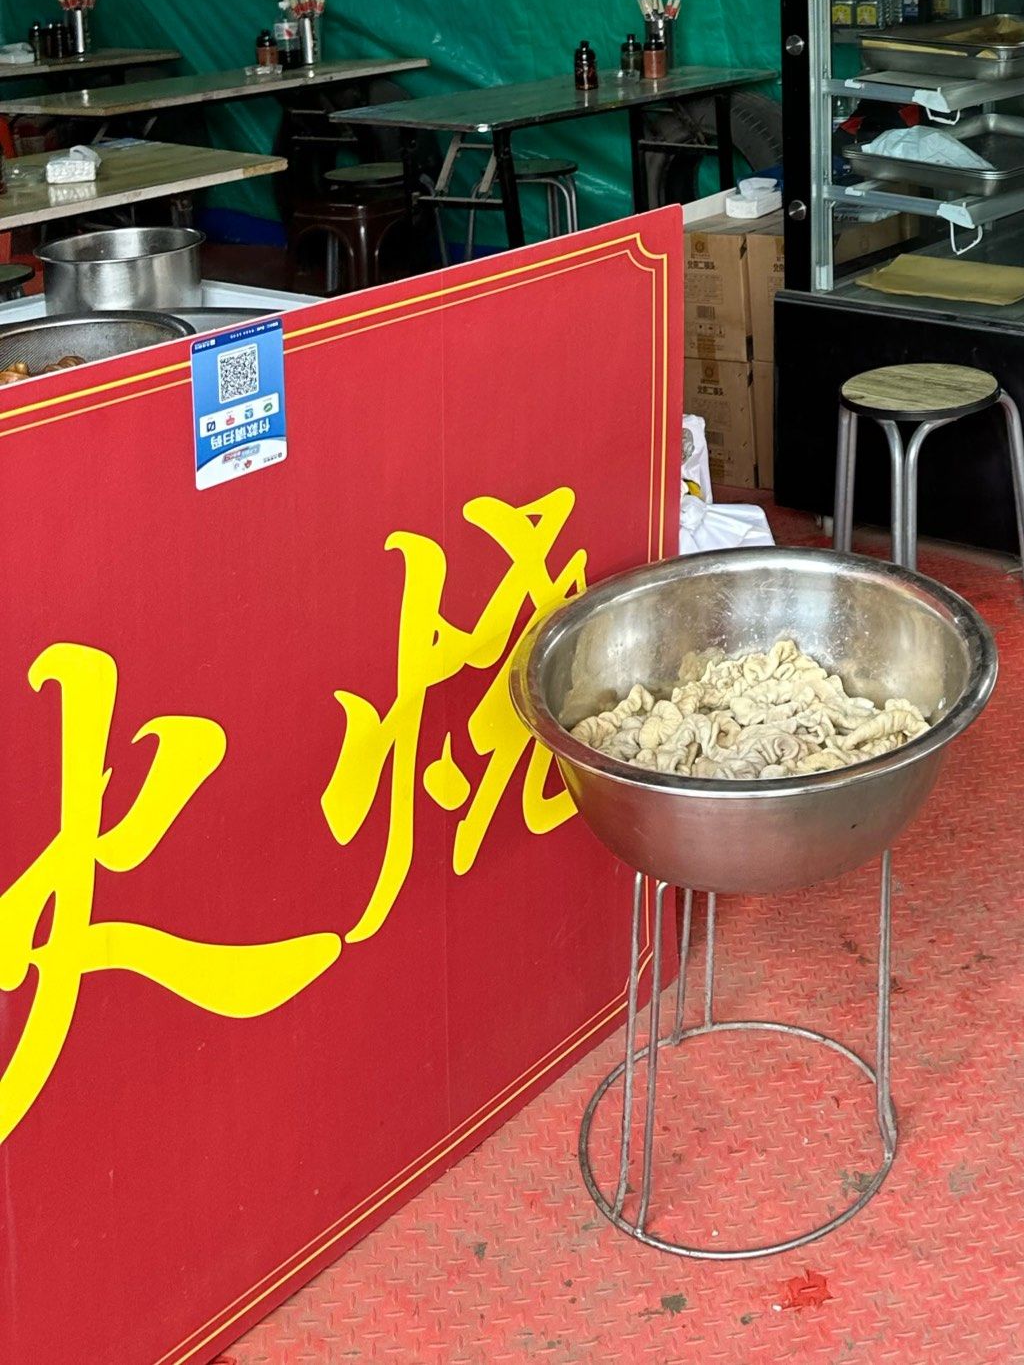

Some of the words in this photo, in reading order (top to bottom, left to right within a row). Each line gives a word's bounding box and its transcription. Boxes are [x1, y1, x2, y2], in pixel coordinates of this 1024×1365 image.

[210, 417, 271, 450] 付款请扫码
